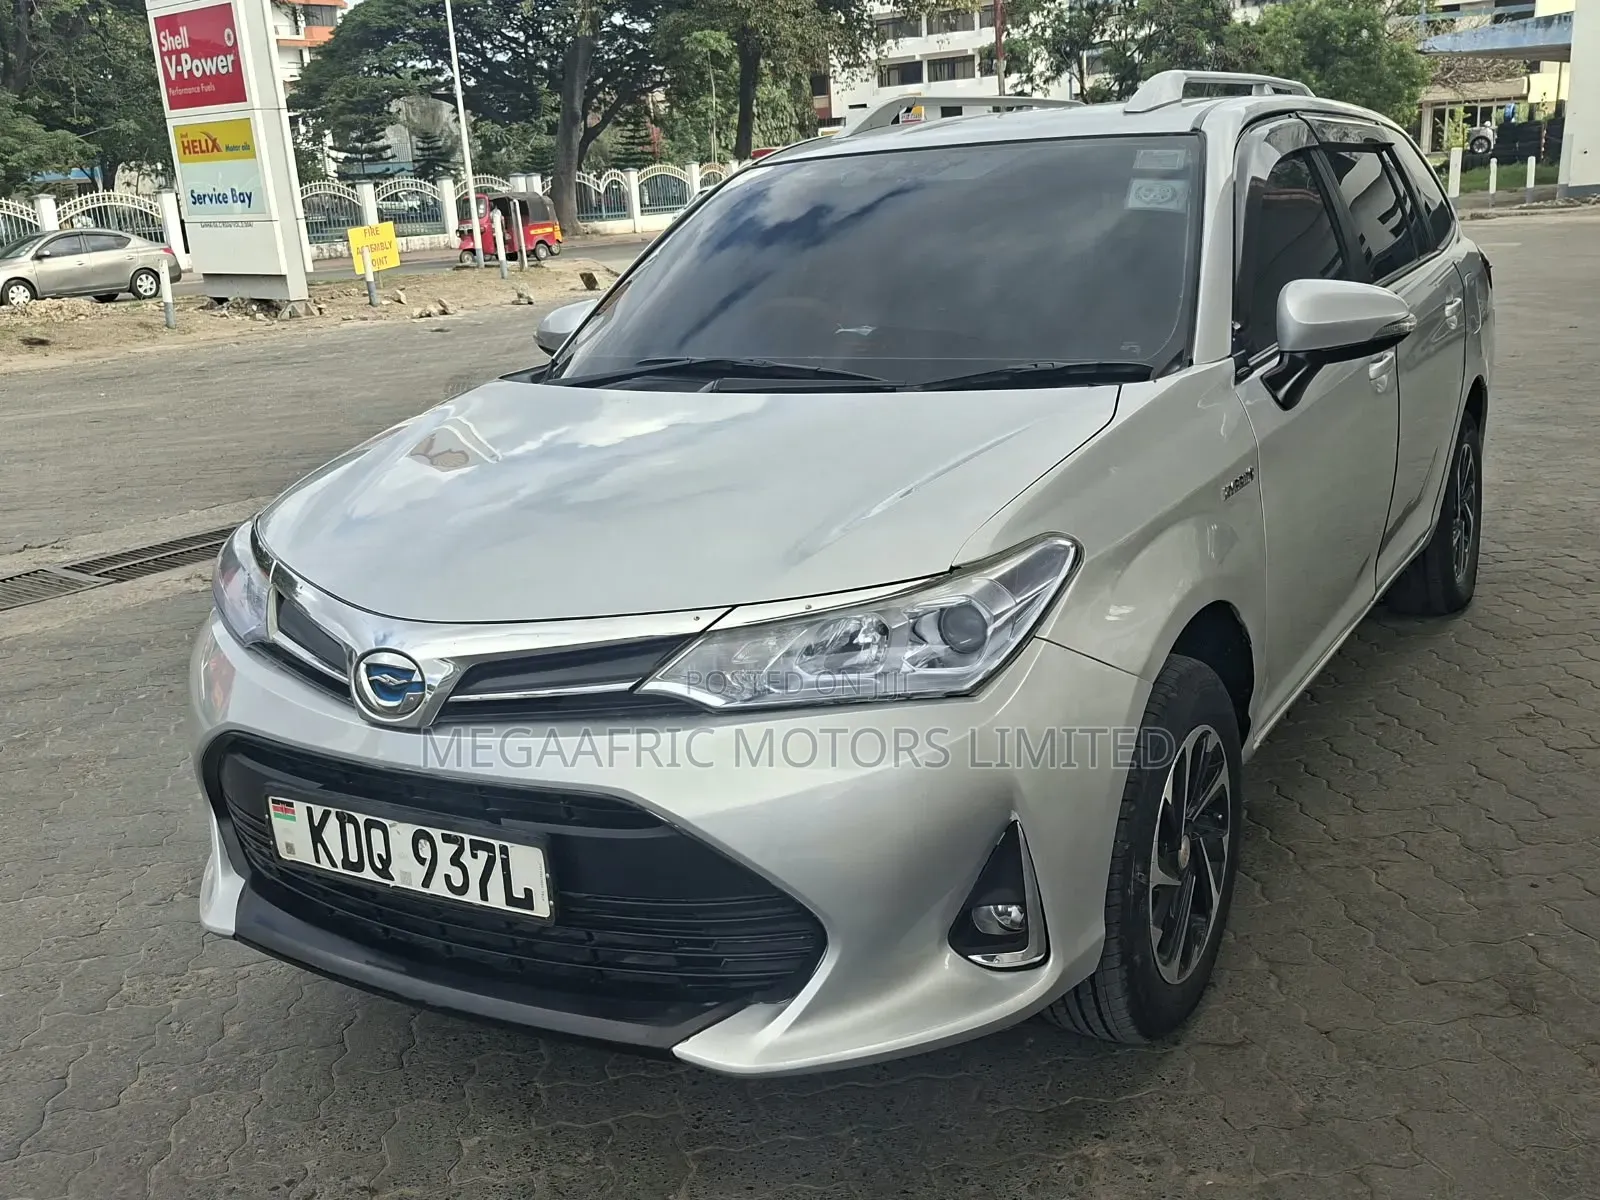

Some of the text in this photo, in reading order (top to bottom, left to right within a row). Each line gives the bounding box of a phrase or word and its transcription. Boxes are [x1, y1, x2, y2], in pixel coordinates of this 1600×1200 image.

[160, 26, 189, 51] Shell
[164, 53, 234, 80] V-Power
[201, 82, 215, 92] Fuels
[181, 136, 222, 155] HELIX
[190, 187, 252, 208] Service Bay
[364, 227, 380, 238] FIRE
[357, 241, 392, 255] AEMBLY
[372, 256, 387, 268] OINT
[306, 805, 396, 881] KDQ
[411, 828, 535, 911] 937L
